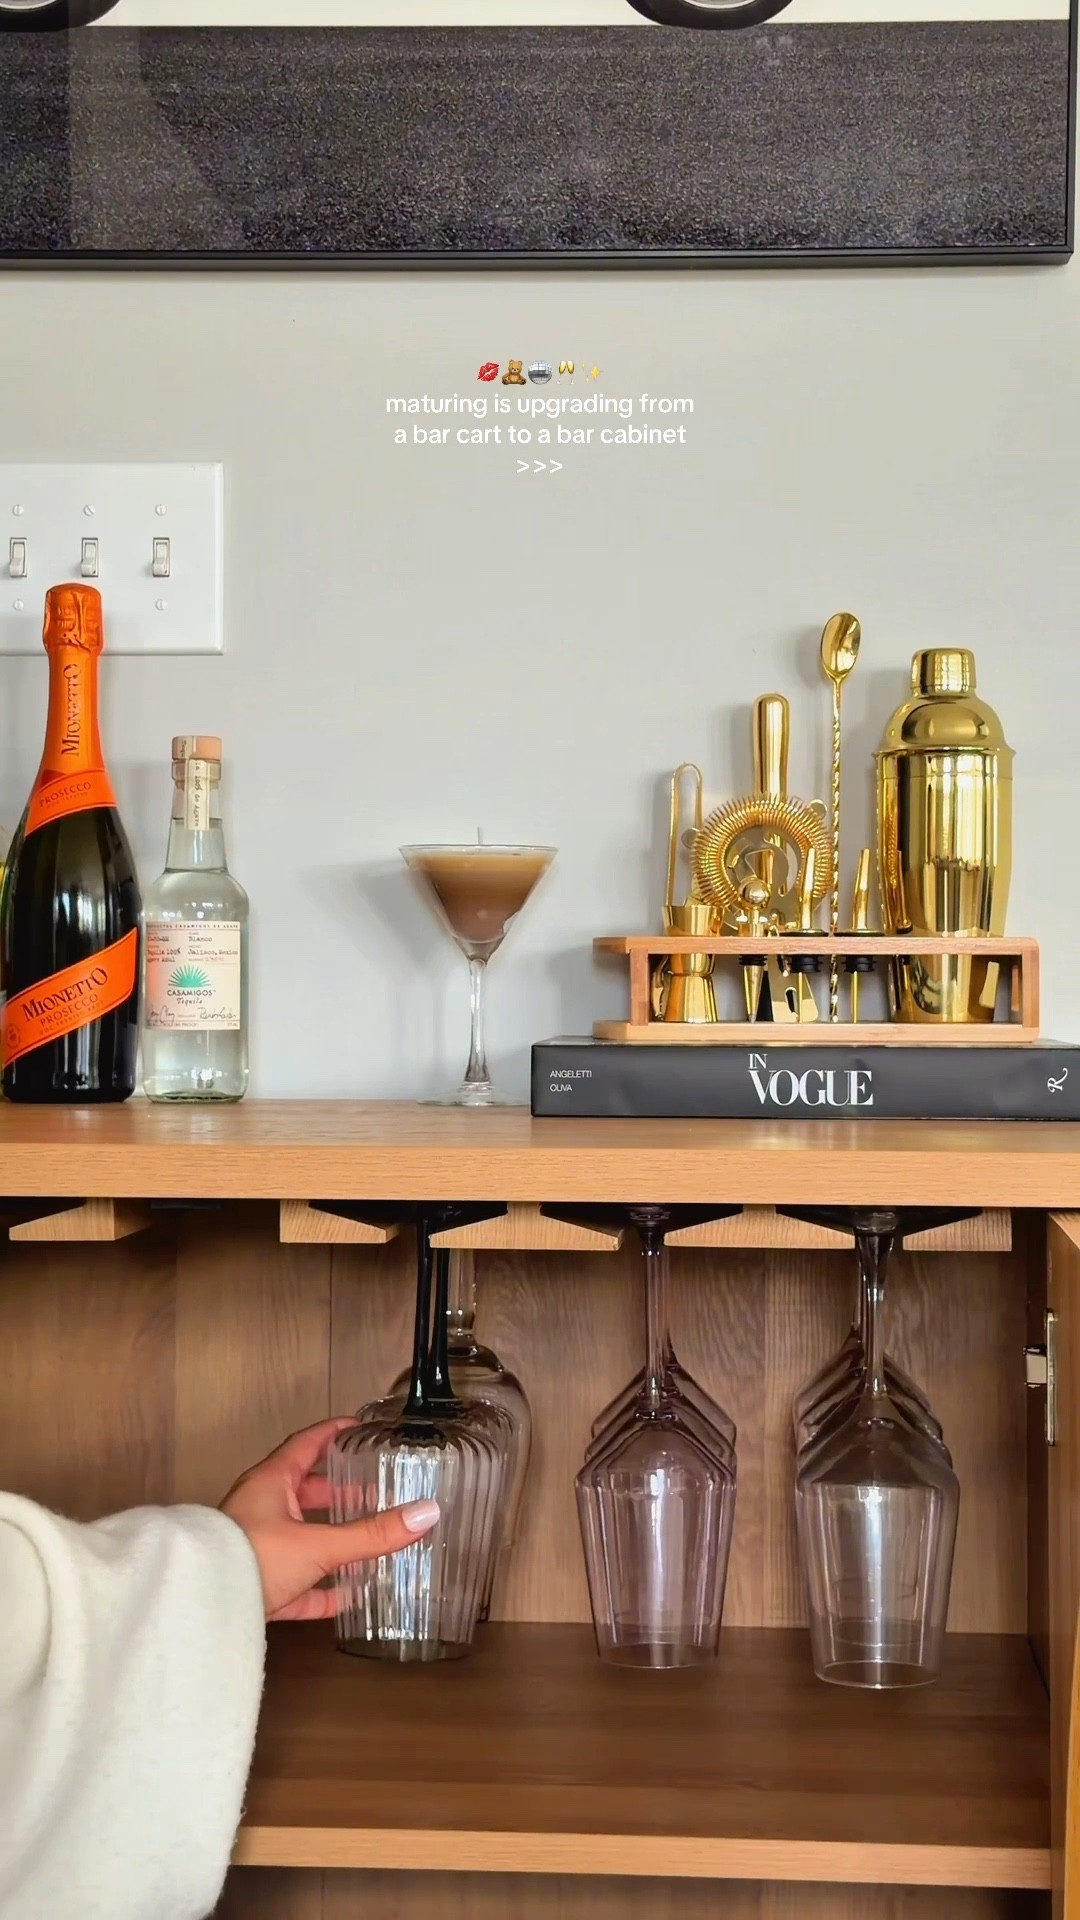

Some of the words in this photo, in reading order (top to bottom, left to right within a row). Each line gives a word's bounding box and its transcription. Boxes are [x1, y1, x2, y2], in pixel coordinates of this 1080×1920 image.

[39, 781, 92, 807] PROSECCO
[23, 967, 108, 1022] MIONETTO
[40, 994, 98, 1027] PROSECCO
[550, 1070, 592, 1078] ANGELETTI
[748, 1053, 767, 1069] IN
[550, 1083, 572, 1092] OLIVA
[748, 1069, 873, 1106] VOGUE
